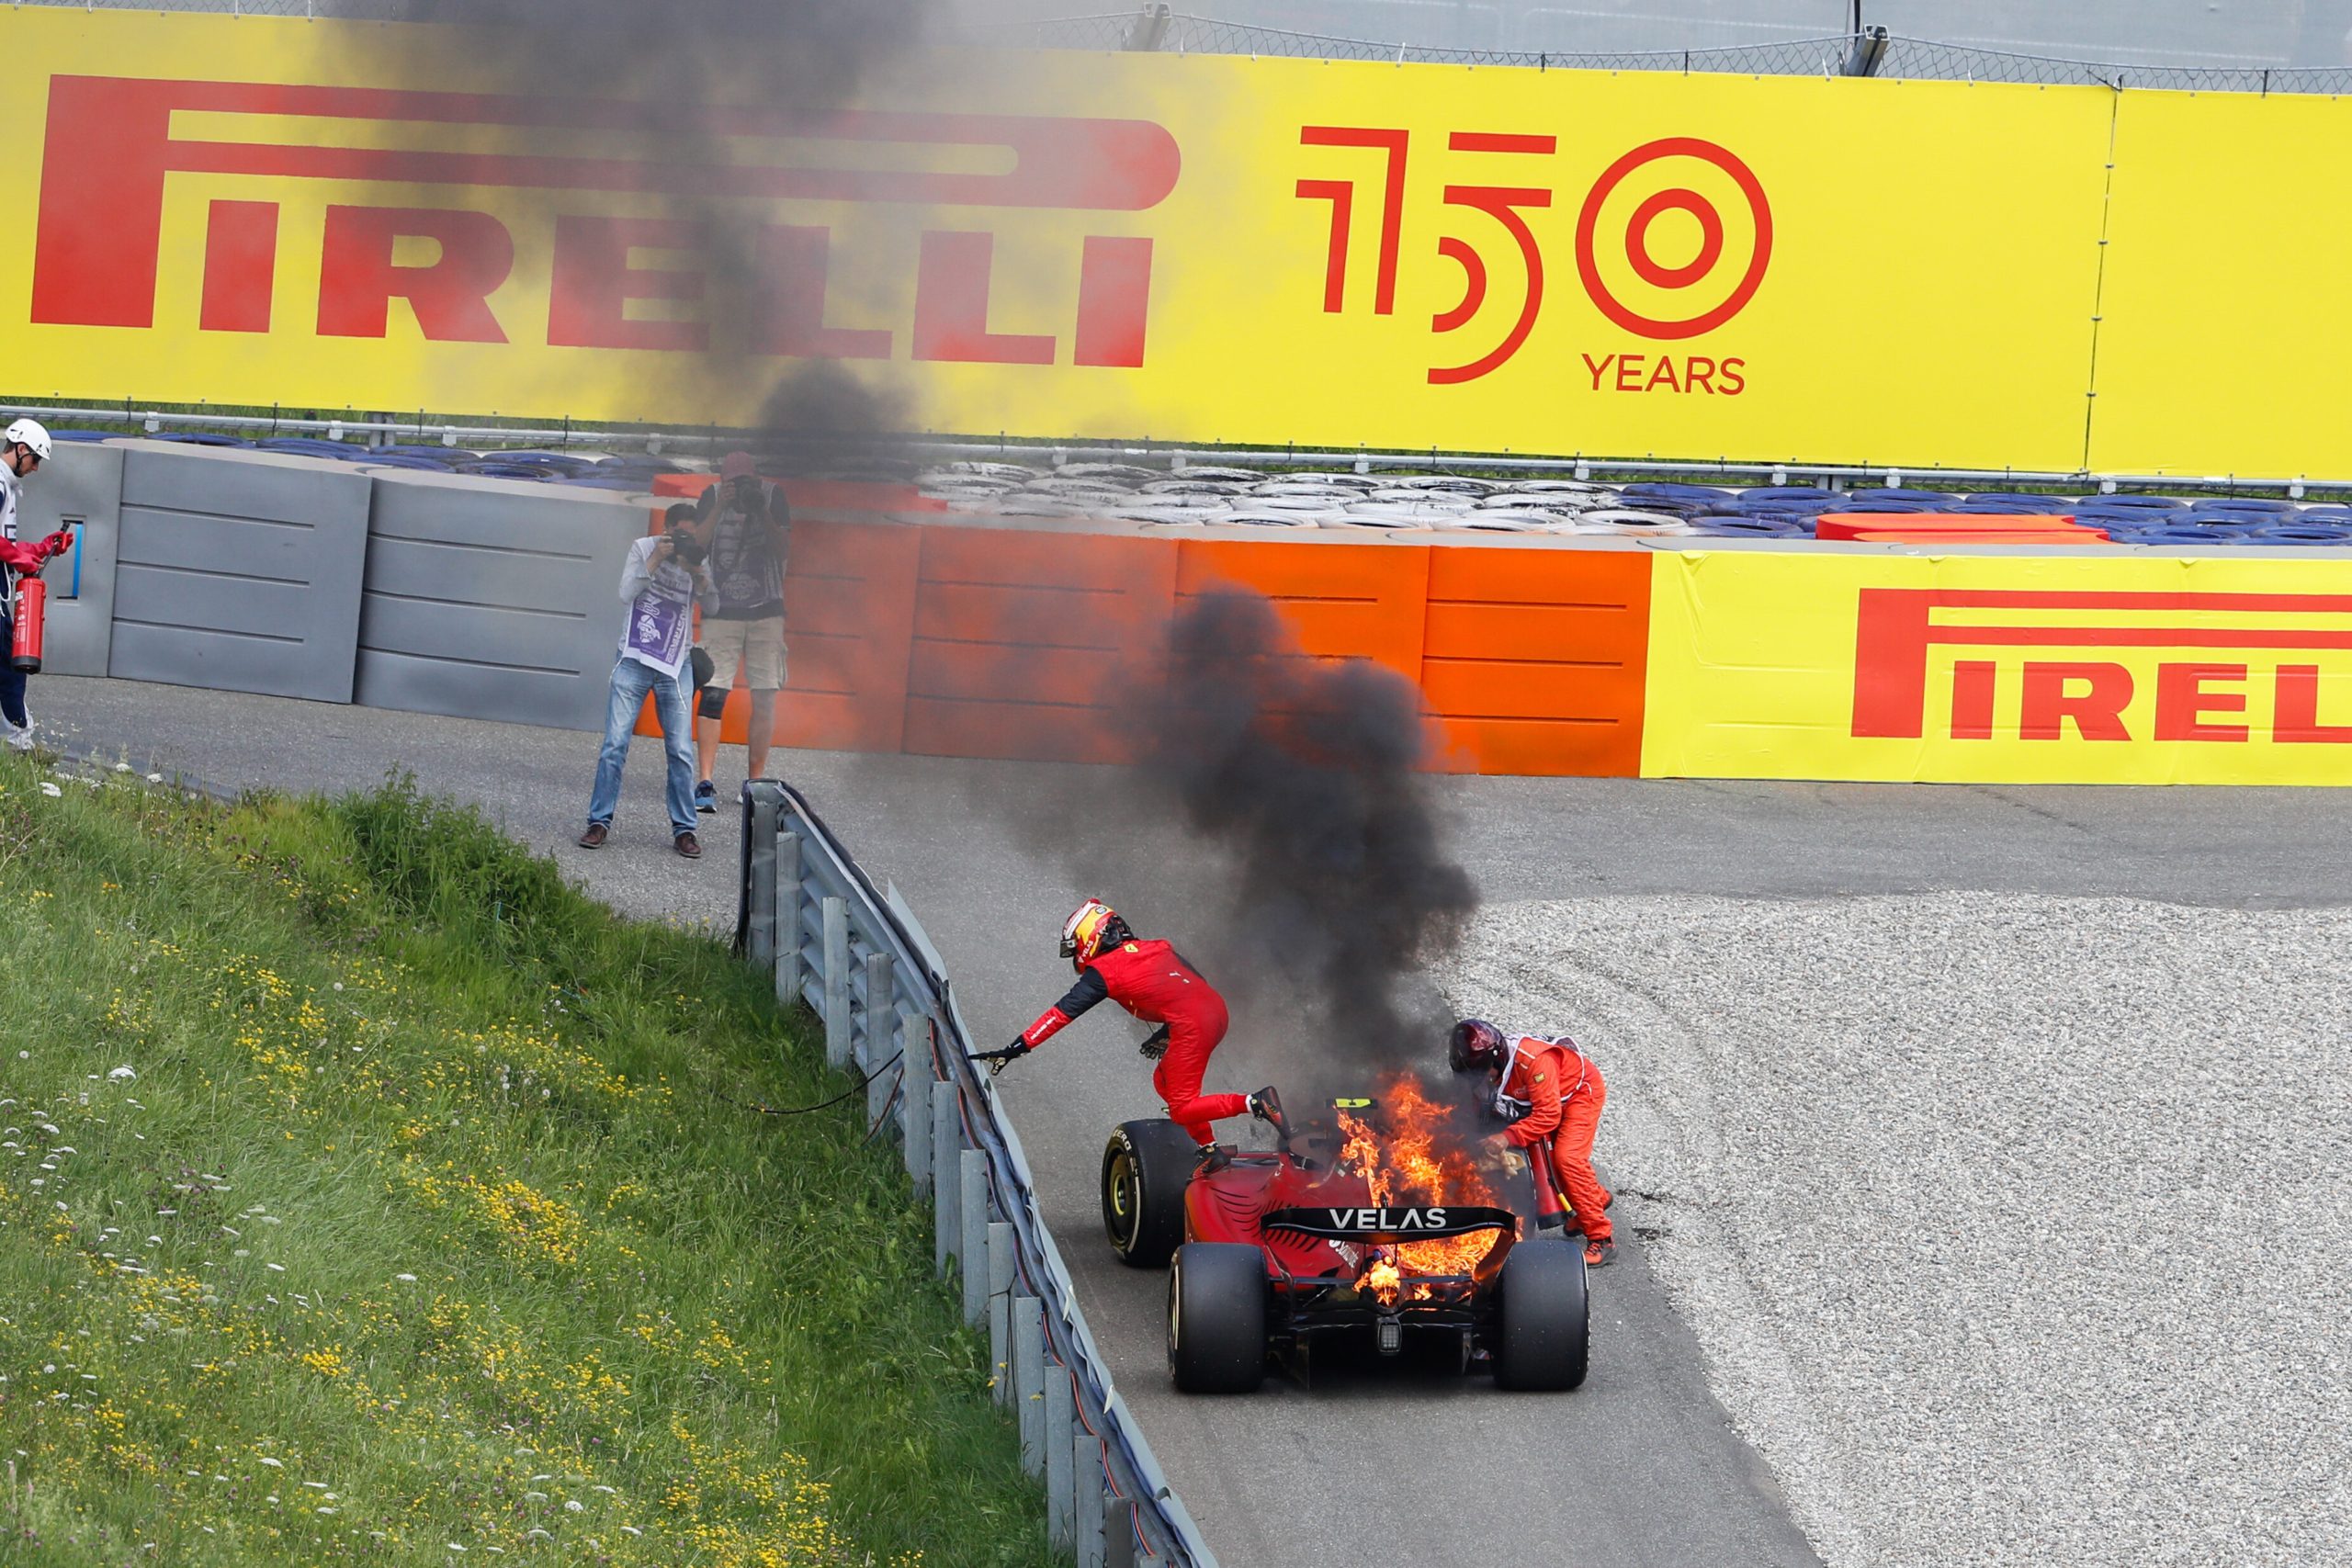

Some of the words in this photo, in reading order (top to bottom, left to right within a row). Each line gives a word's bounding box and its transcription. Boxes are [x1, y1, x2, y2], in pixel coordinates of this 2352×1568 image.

[30, 74, 1182, 368] PIRELLI
[1296, 126, 1773, 384] 150
[1580, 353, 1746, 396] YEARS
[1329, 1208, 1446, 1229] VELAS
